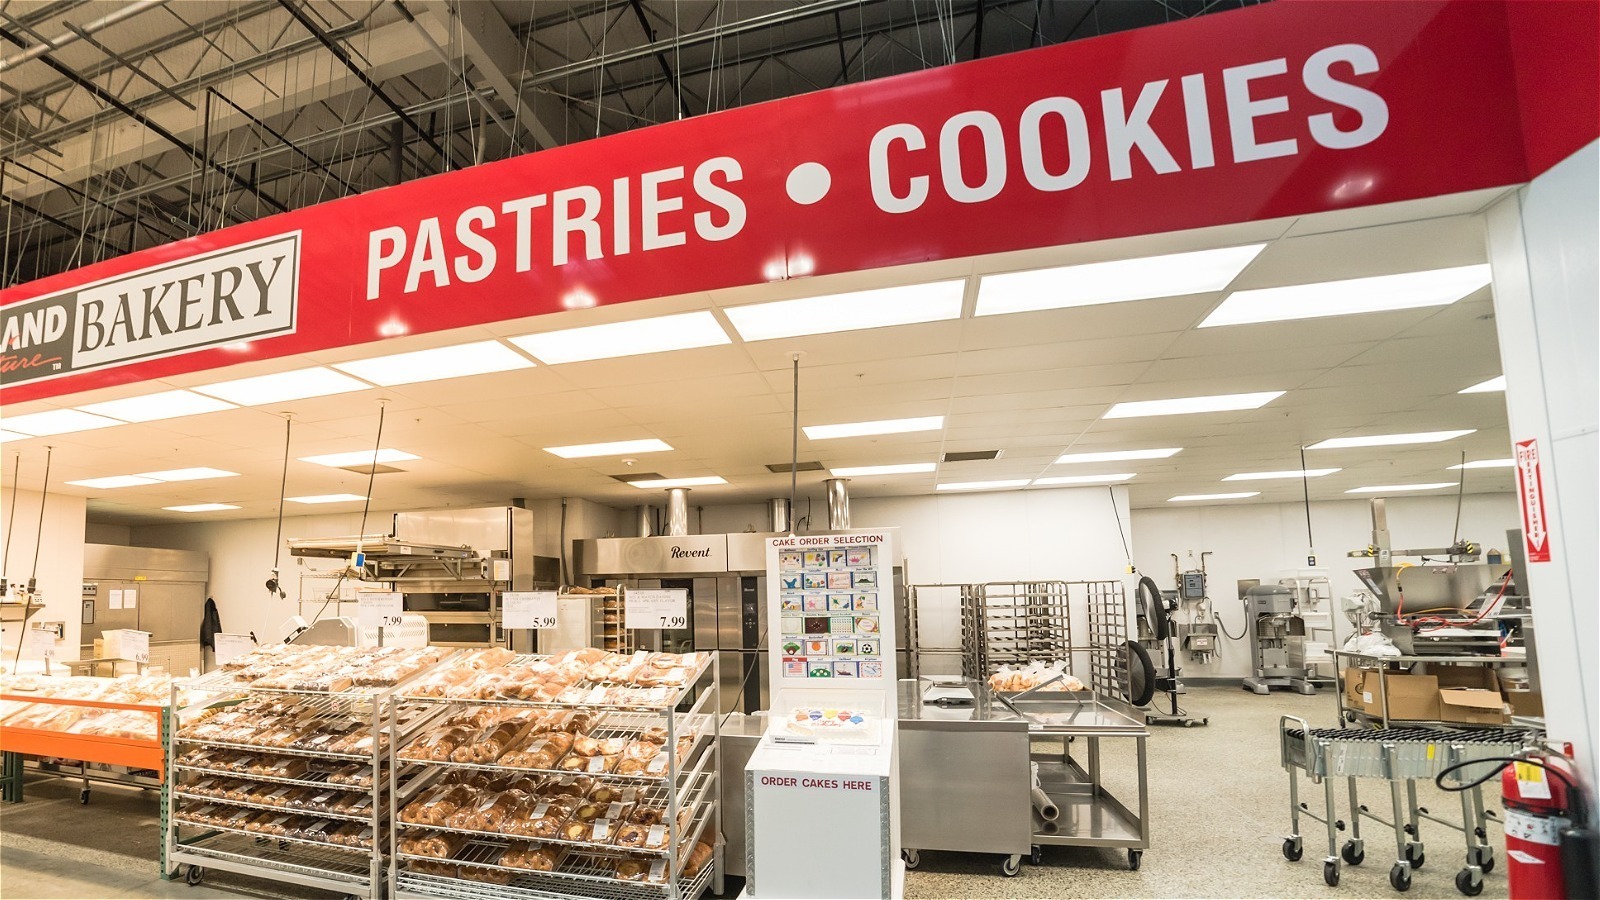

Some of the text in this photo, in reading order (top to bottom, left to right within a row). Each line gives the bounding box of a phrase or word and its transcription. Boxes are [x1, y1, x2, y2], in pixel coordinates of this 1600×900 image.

[366, 43, 1389, 301] PASTRIES COOKIES
[77, 255, 286, 353] BAKERY
[0, 305, 67, 354] AND
[772, 535, 884, 547] CAKE ORDER SELECTION
[670, 545, 710, 559] Revent
[383, 616, 402, 626] 7.99
[532, 617, 556, 628] 5.99
[660, 616, 685, 628] 7.99
[761, 776, 872, 791] ORDER CAKES HERE
